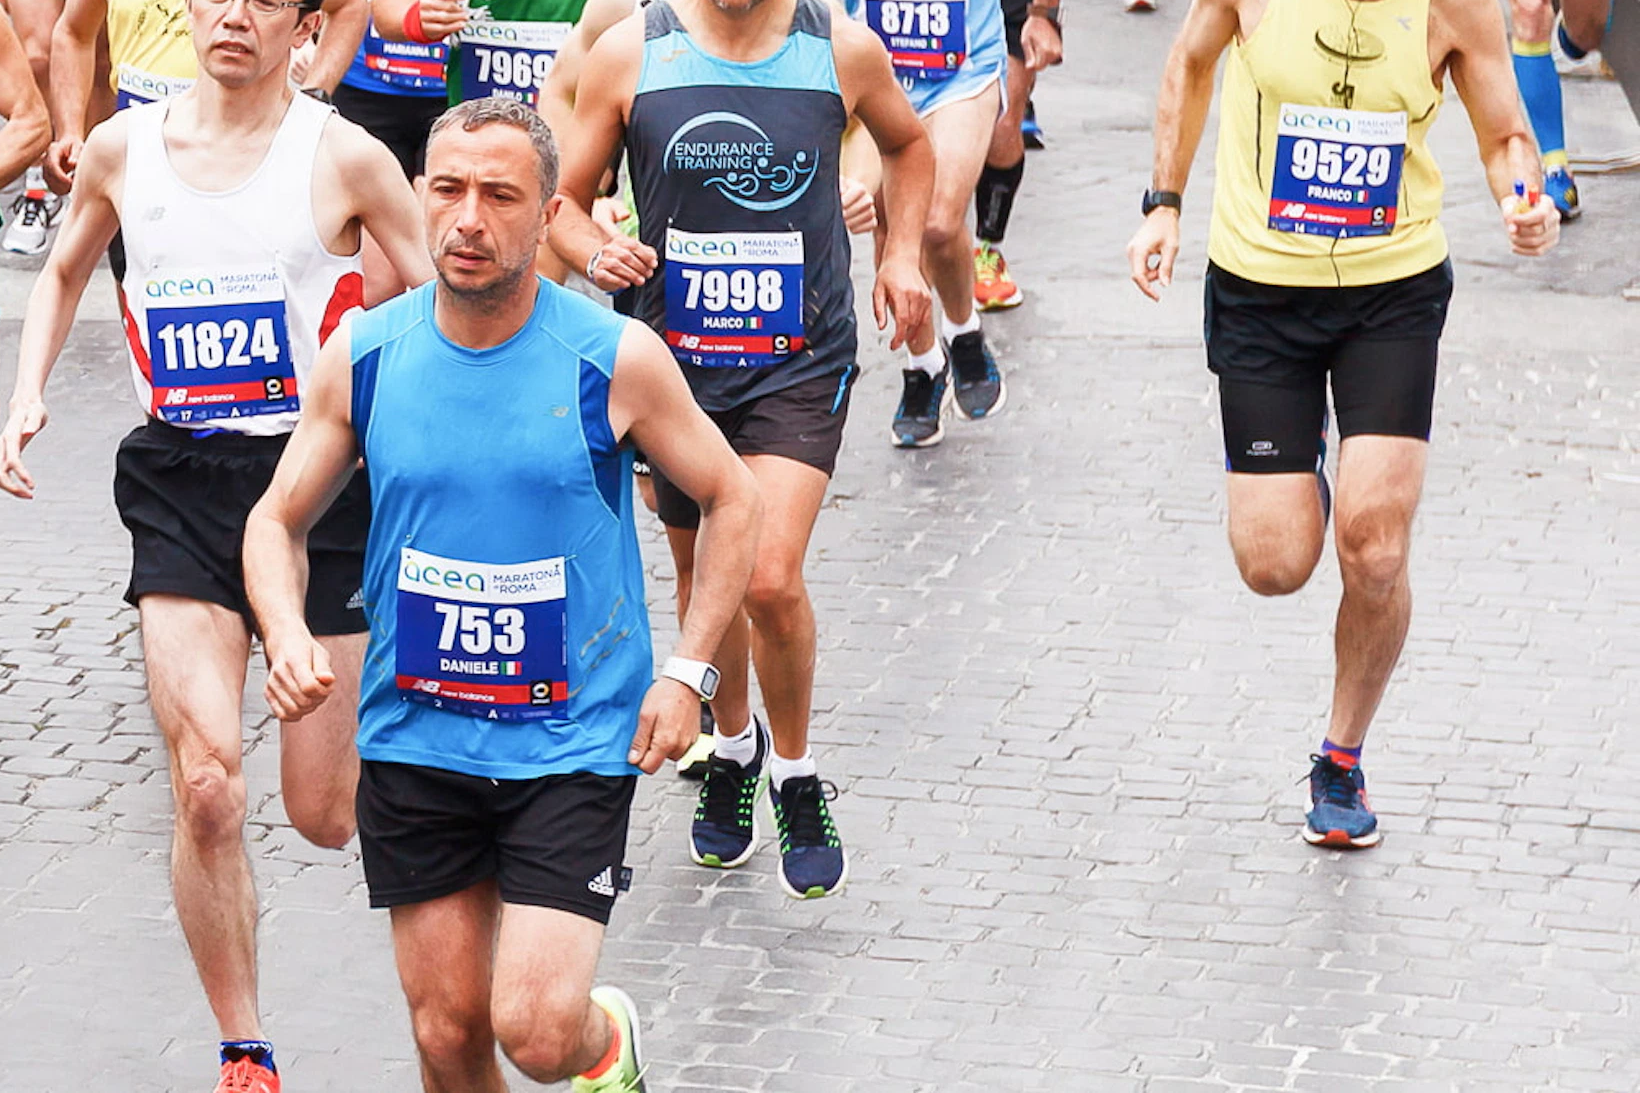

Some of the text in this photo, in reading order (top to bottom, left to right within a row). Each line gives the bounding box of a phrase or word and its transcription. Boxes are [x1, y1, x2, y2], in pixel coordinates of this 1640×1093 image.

[881, 1, 950, 36] 8713
[462, 21, 518, 41] acea
[383, 42, 431, 58] MARIANNA
[891, 36, 928, 49] STEFANO
[474, 47, 554, 89] 7969
[1282, 110, 1351, 134] acea
[674, 142, 775, 157] ENDURANCE
[674, 156, 753, 171] TRAINING
[1290, 137, 1392, 187] 9529
[1307, 184, 1353, 204] FRANCO
[669, 234, 738, 257] acea
[146, 278, 214, 297] acea
[681, 269, 784, 312] 7998
[702, 316, 744, 329] MARCO
[157, 318, 280, 371] 11824
[405, 561, 562, 593] acea MARATONA
[499, 583, 538, 595] ROMA
[434, 601, 526, 655] 753
[440, 658, 499, 675] DANIELE
[488, 708, 498, 720] A
